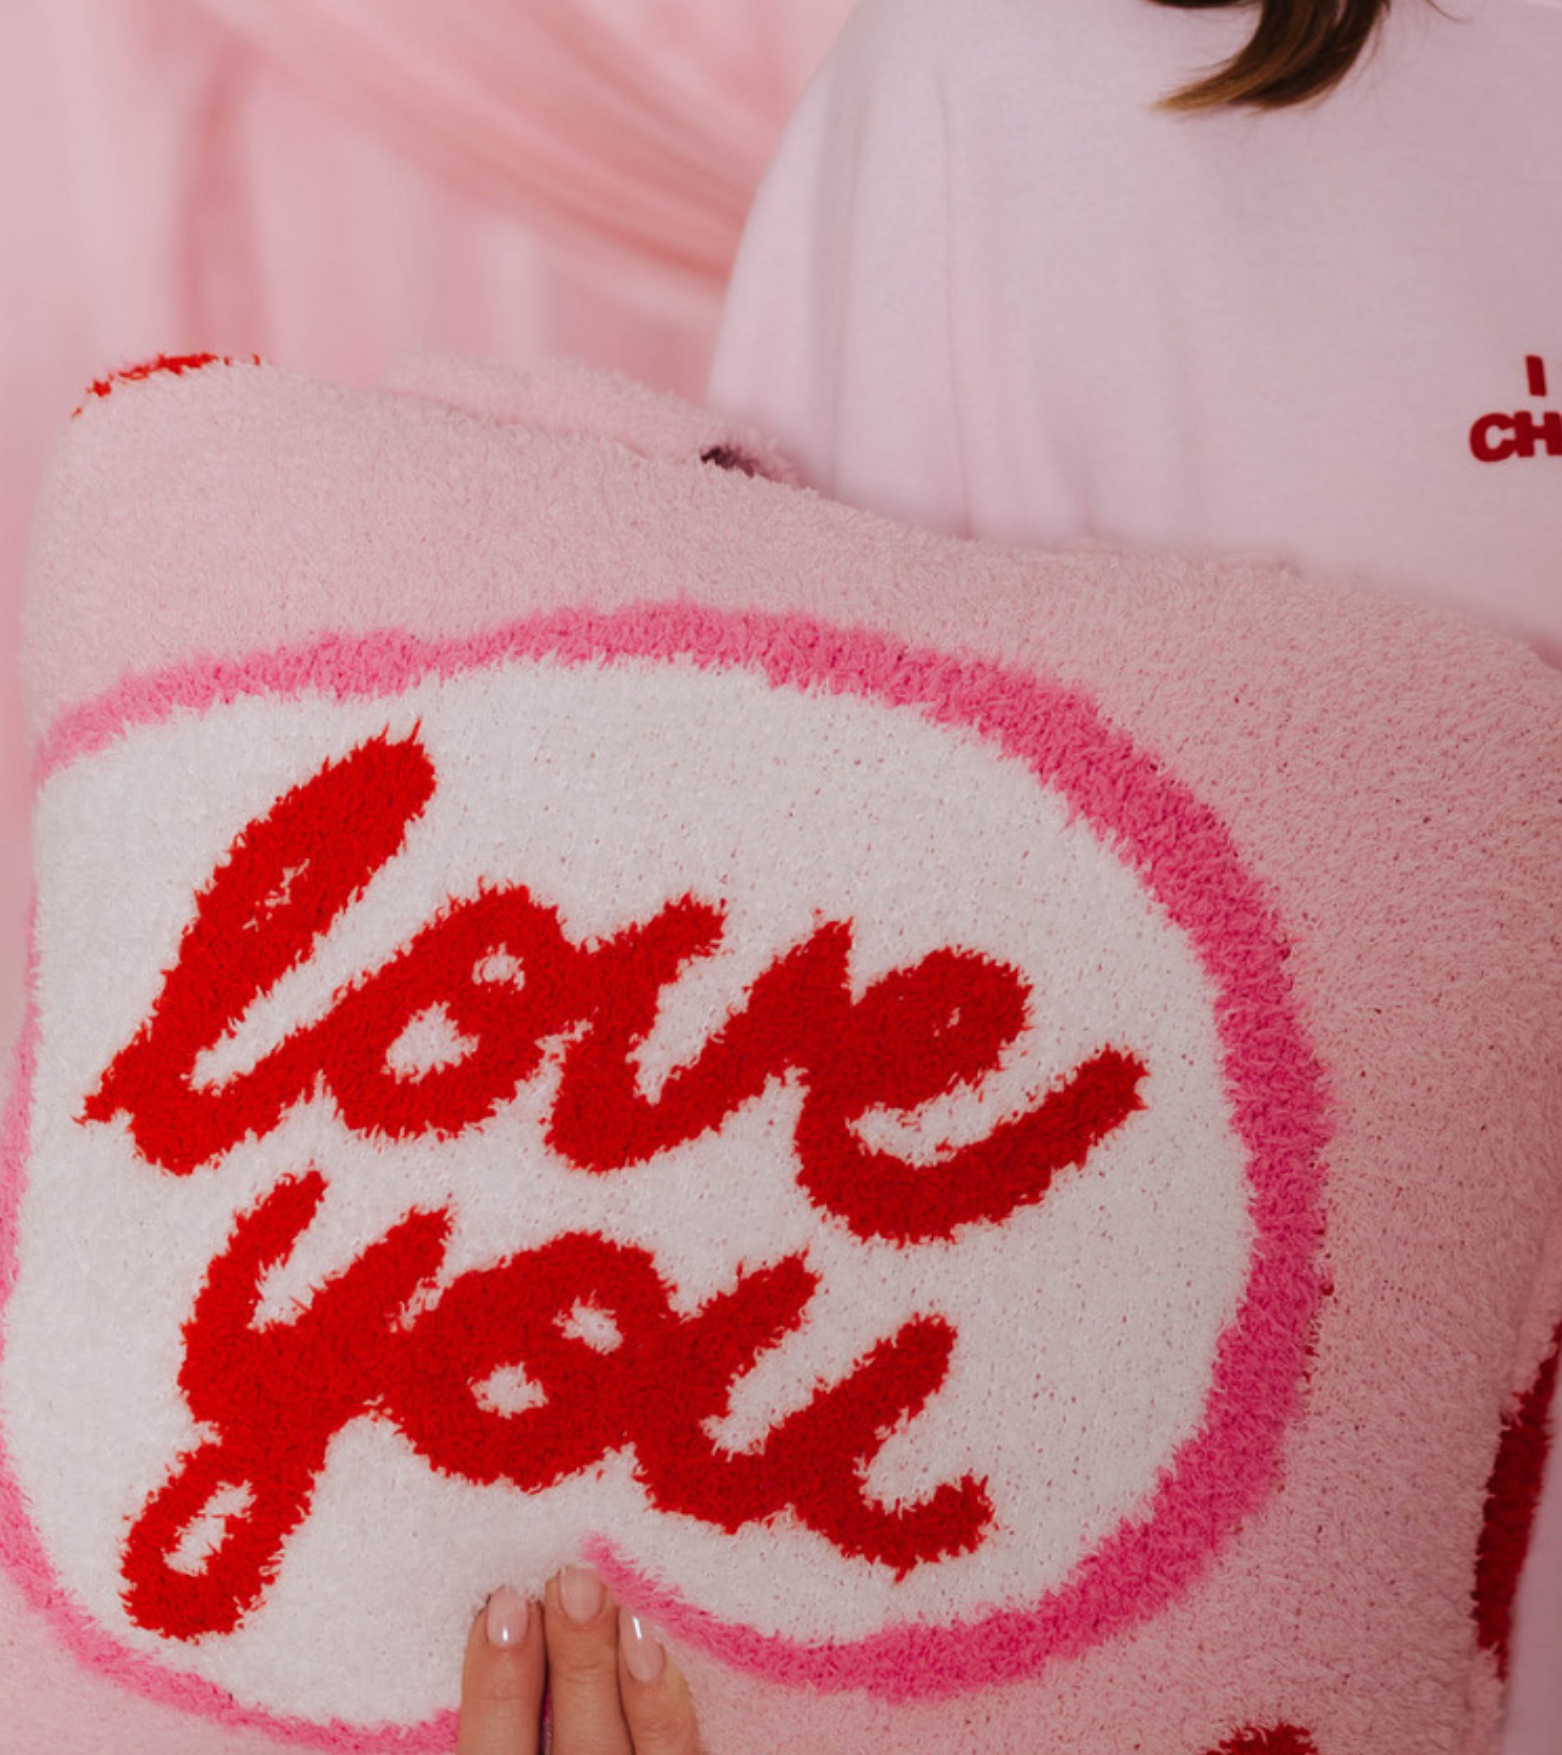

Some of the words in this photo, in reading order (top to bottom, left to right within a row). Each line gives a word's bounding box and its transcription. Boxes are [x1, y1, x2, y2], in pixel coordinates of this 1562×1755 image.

[1525, 355, 1547, 397] I
[78, 724, 1147, 1243] love
[120, 1169, 995, 1642] you
